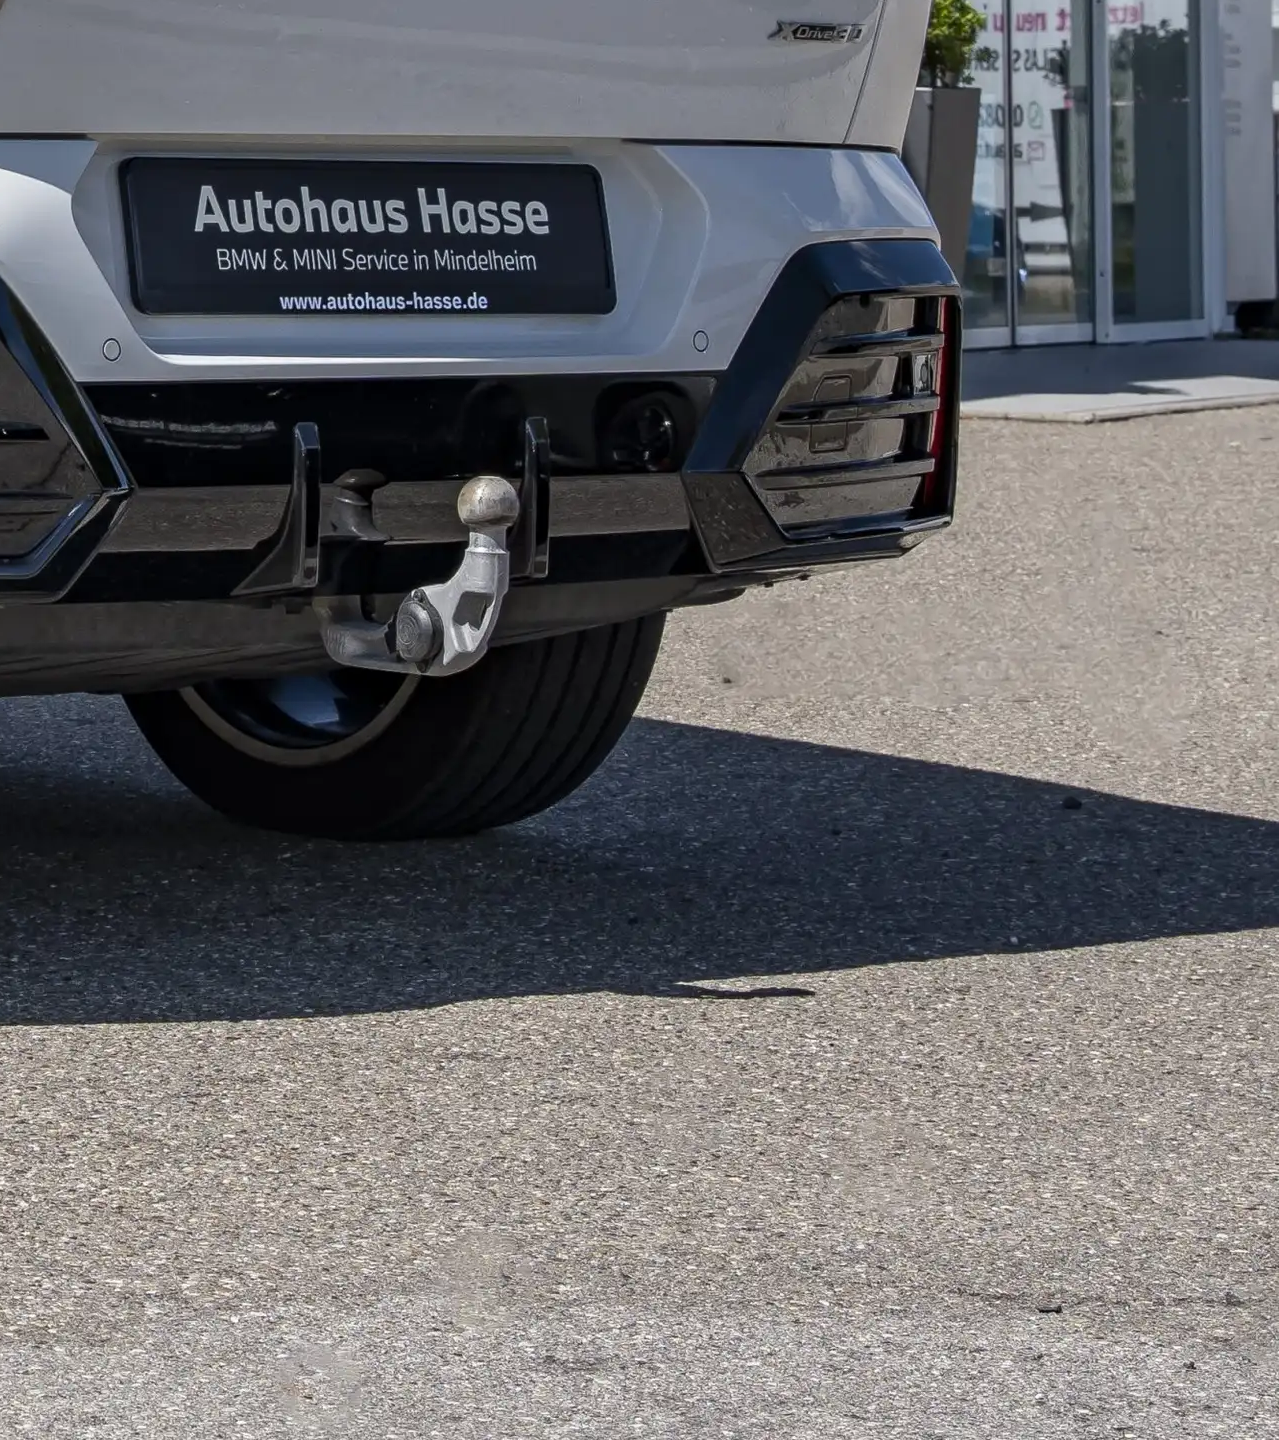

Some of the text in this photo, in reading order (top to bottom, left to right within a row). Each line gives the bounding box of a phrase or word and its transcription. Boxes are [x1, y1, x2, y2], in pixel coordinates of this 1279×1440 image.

[194, 185, 550, 235] Autohaus Hasse
[216, 248, 537, 272] BMW & MINI Service in Mindelheim
[279, 291, 488, 311] www.autohaus-hasse.de
